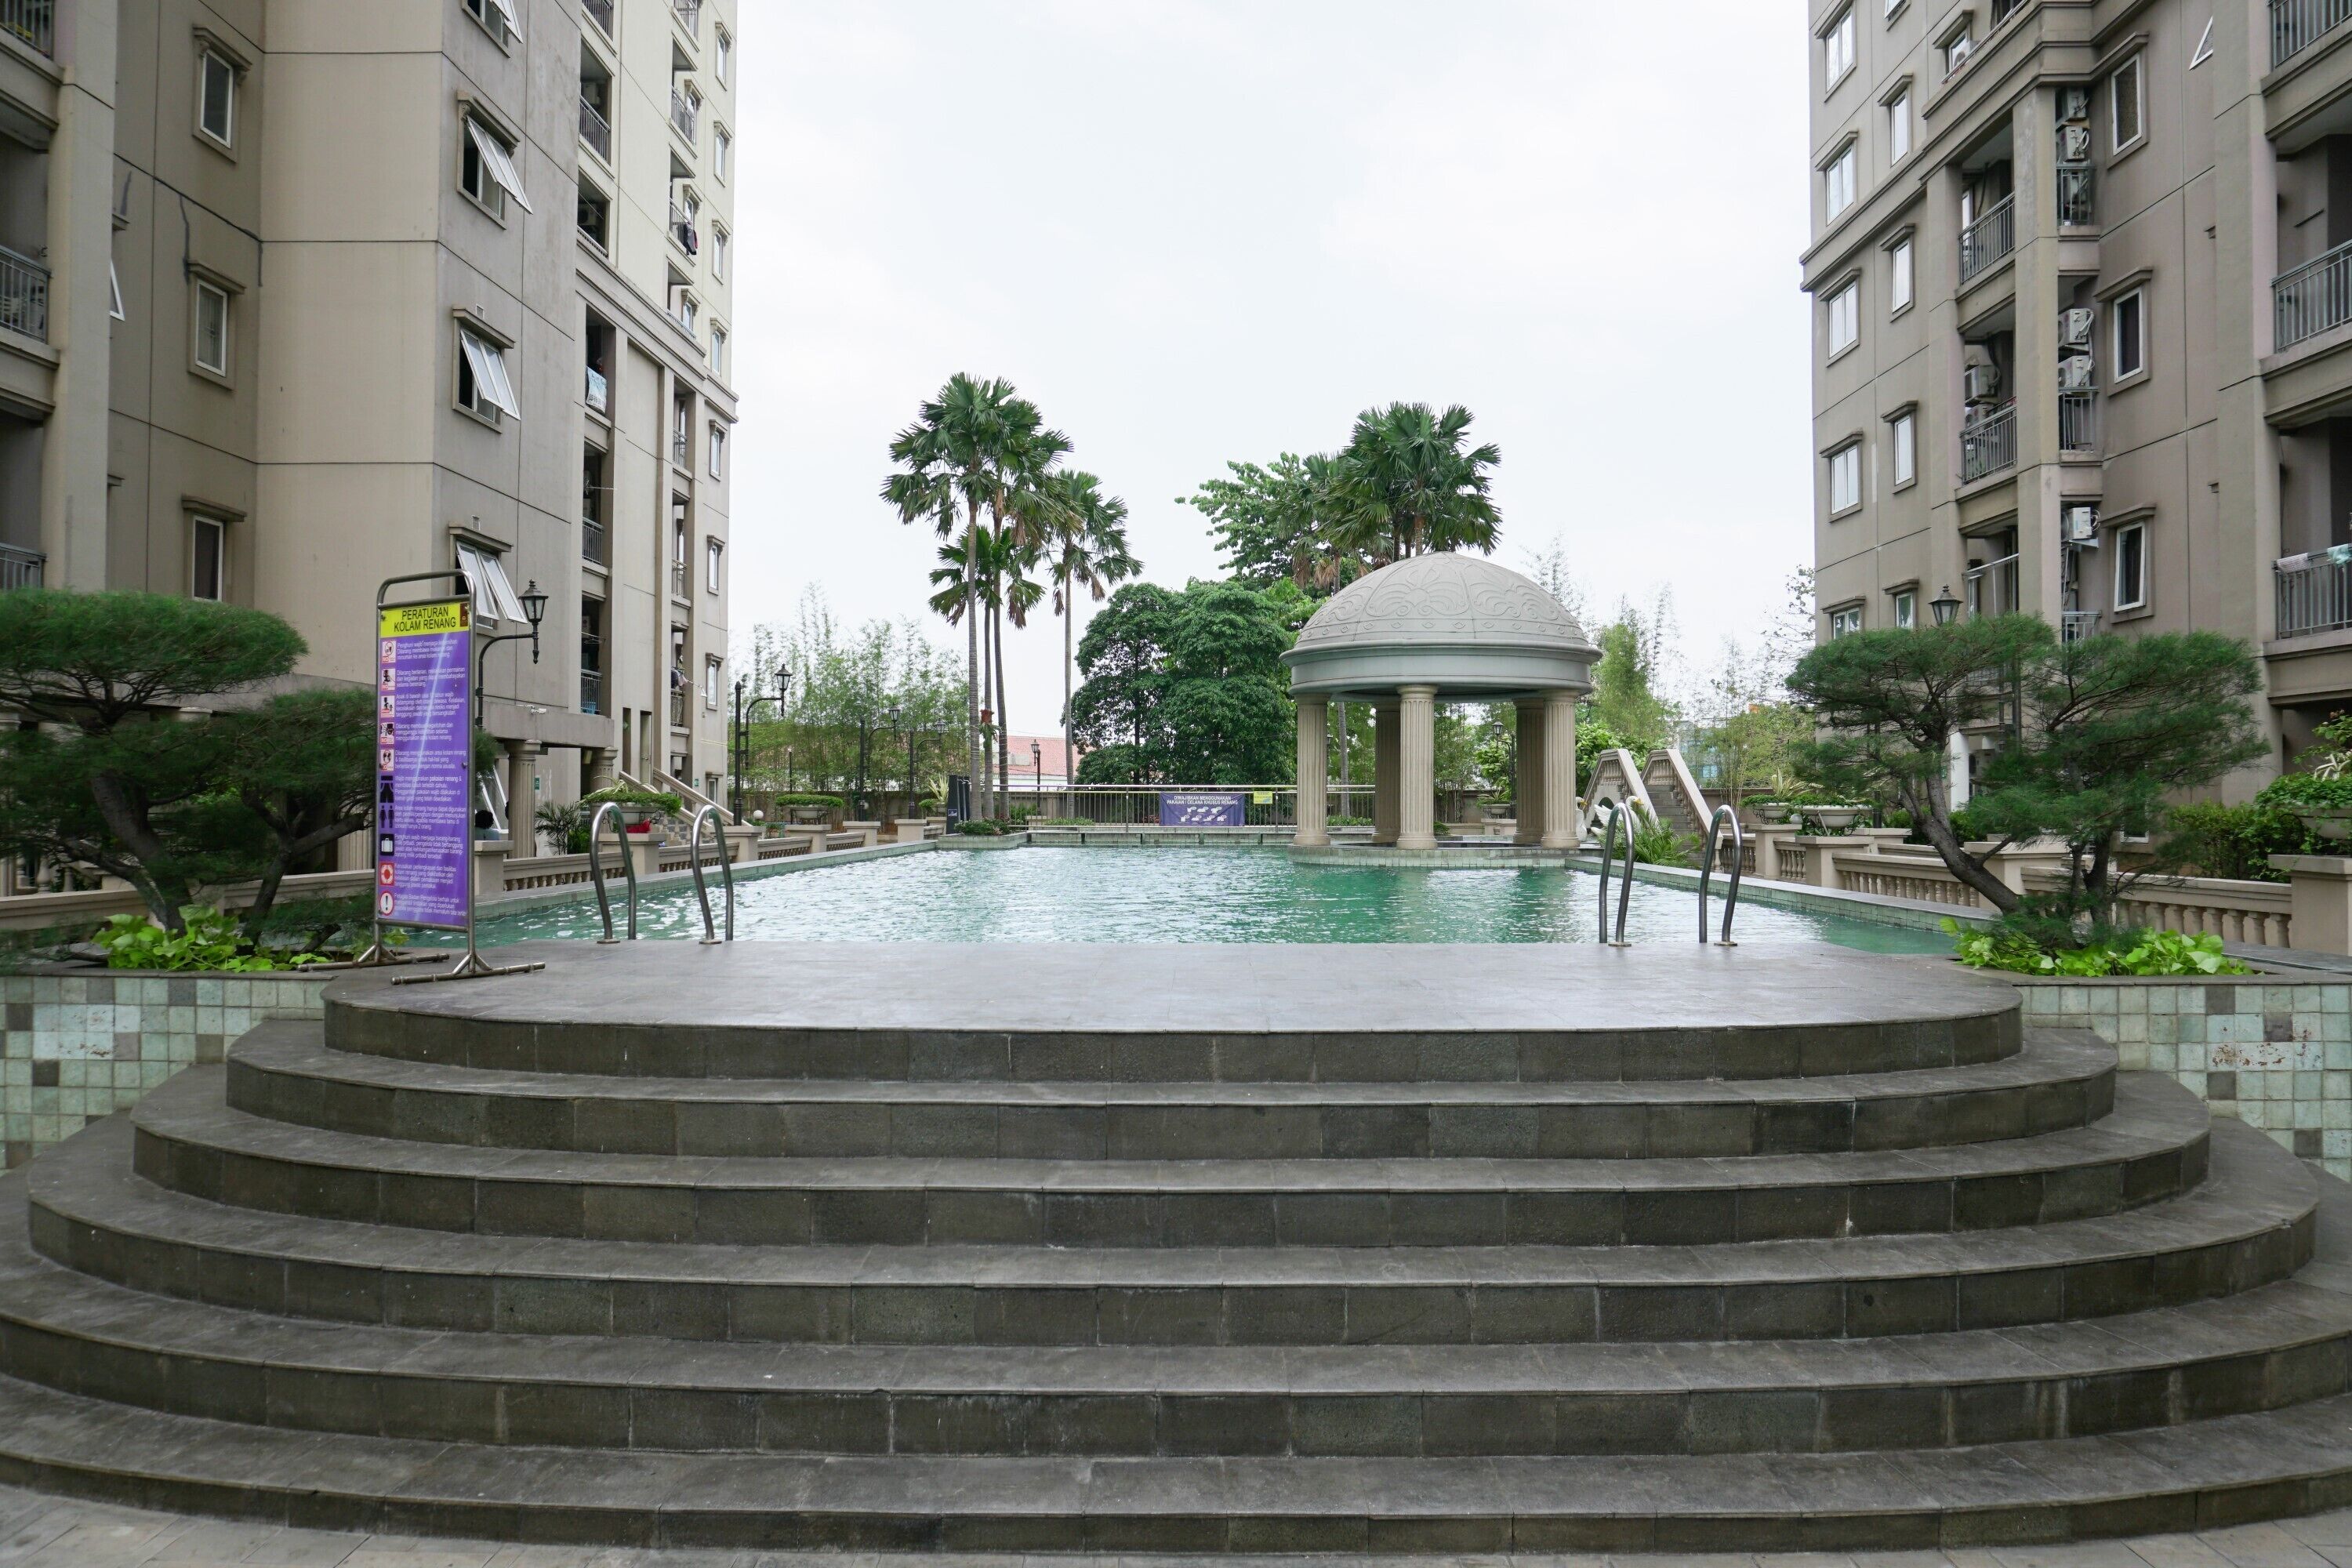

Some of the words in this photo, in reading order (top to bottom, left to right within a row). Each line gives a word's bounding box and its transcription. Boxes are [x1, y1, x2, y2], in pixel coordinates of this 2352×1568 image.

[402, 606, 448, 620] PERATURAN
[394, 620, 421, 632] KOLAM
[424, 617, 456, 629] RENANG
